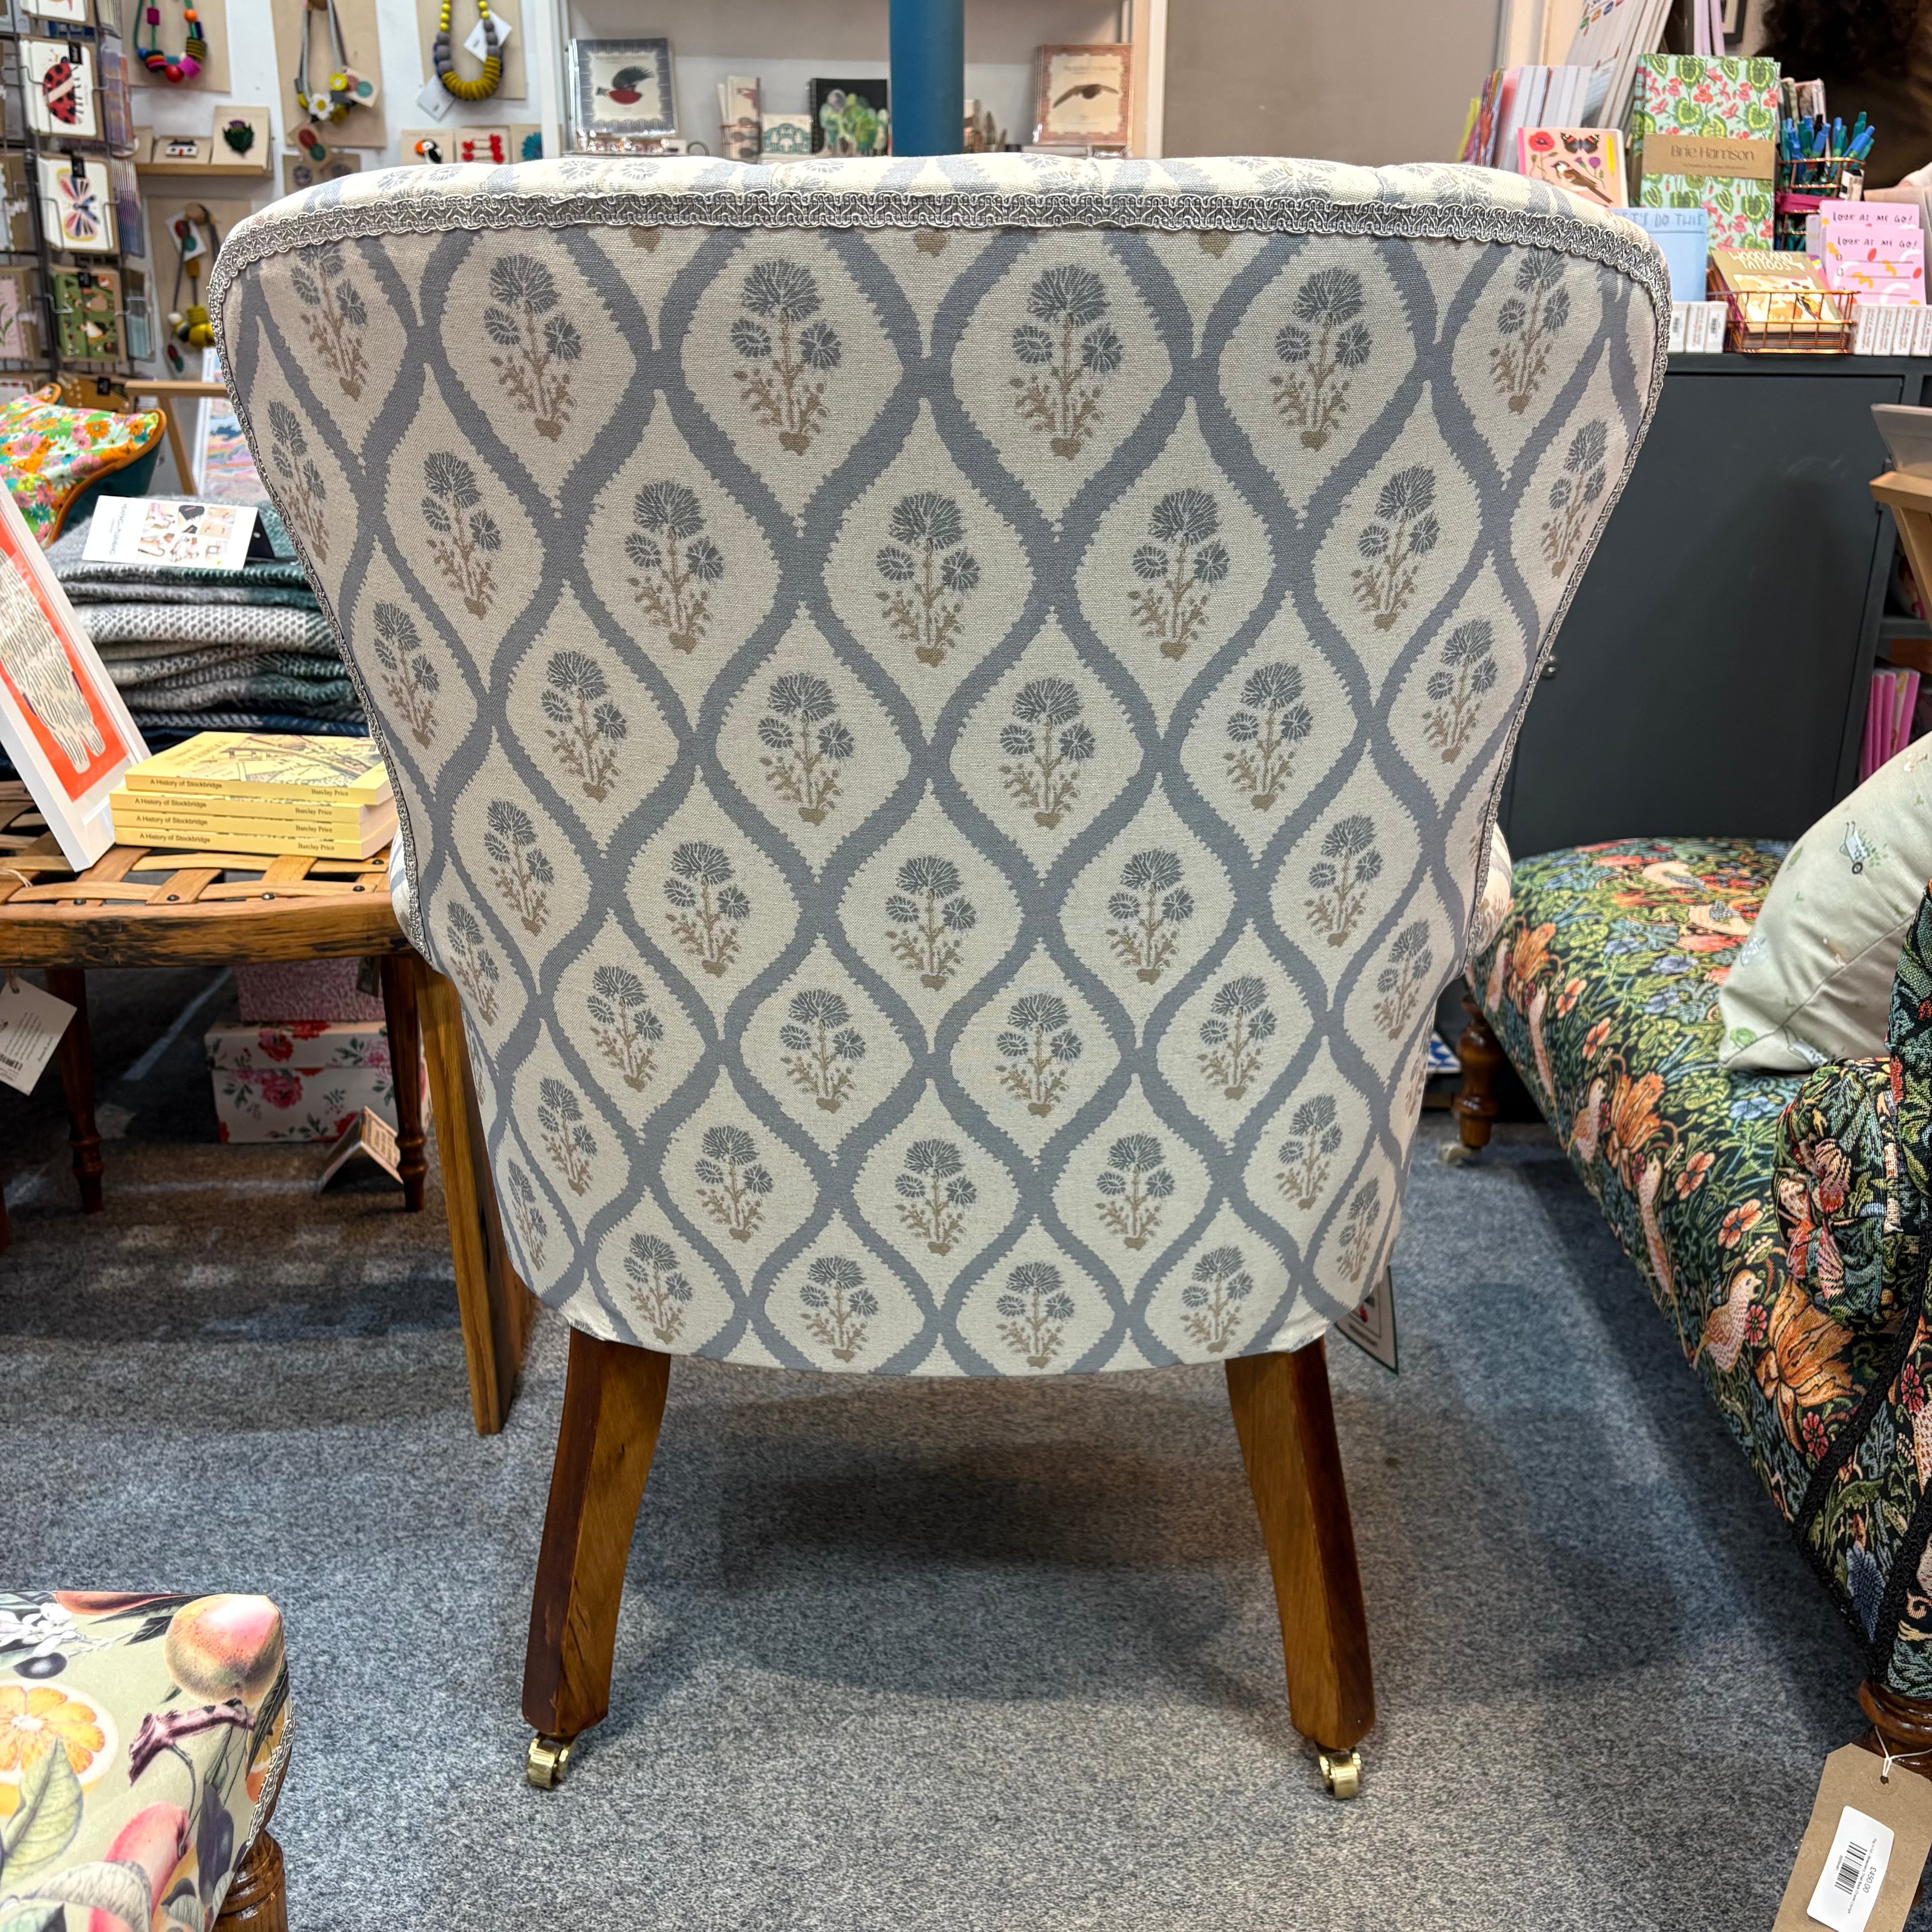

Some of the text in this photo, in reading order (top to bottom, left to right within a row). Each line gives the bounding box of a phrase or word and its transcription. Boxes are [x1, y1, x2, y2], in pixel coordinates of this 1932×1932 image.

[1671, 144, 1754, 161] Brie Harrison
[1655, 213, 1670, 227] DO
[1675, 213, 1704, 226] THIS
[1833, 212, 1855, 221] LOOK
[1837, 235, 1859, 246] LOOK
[1728, 251, 1796, 263] WOODLAND
[1739, 258, 1791, 270] TATTOOS
[156, 779, 177, 787] History
[187, 780, 222, 789] Stockbridge
[311, 788, 332, 796] Barclay
[171, 799, 206, 808] Stockbridge
[295, 807, 316, 815] Barclay
[172, 817, 207, 825] Stockbridge
[296, 825, 316, 833] Barclay
[146, 833, 166, 842] History
[175, 835, 210, 844] Stockbridge
[298, 843, 318, 851] Barclay
[1863, 1866, 1877, 1893] £450.00
